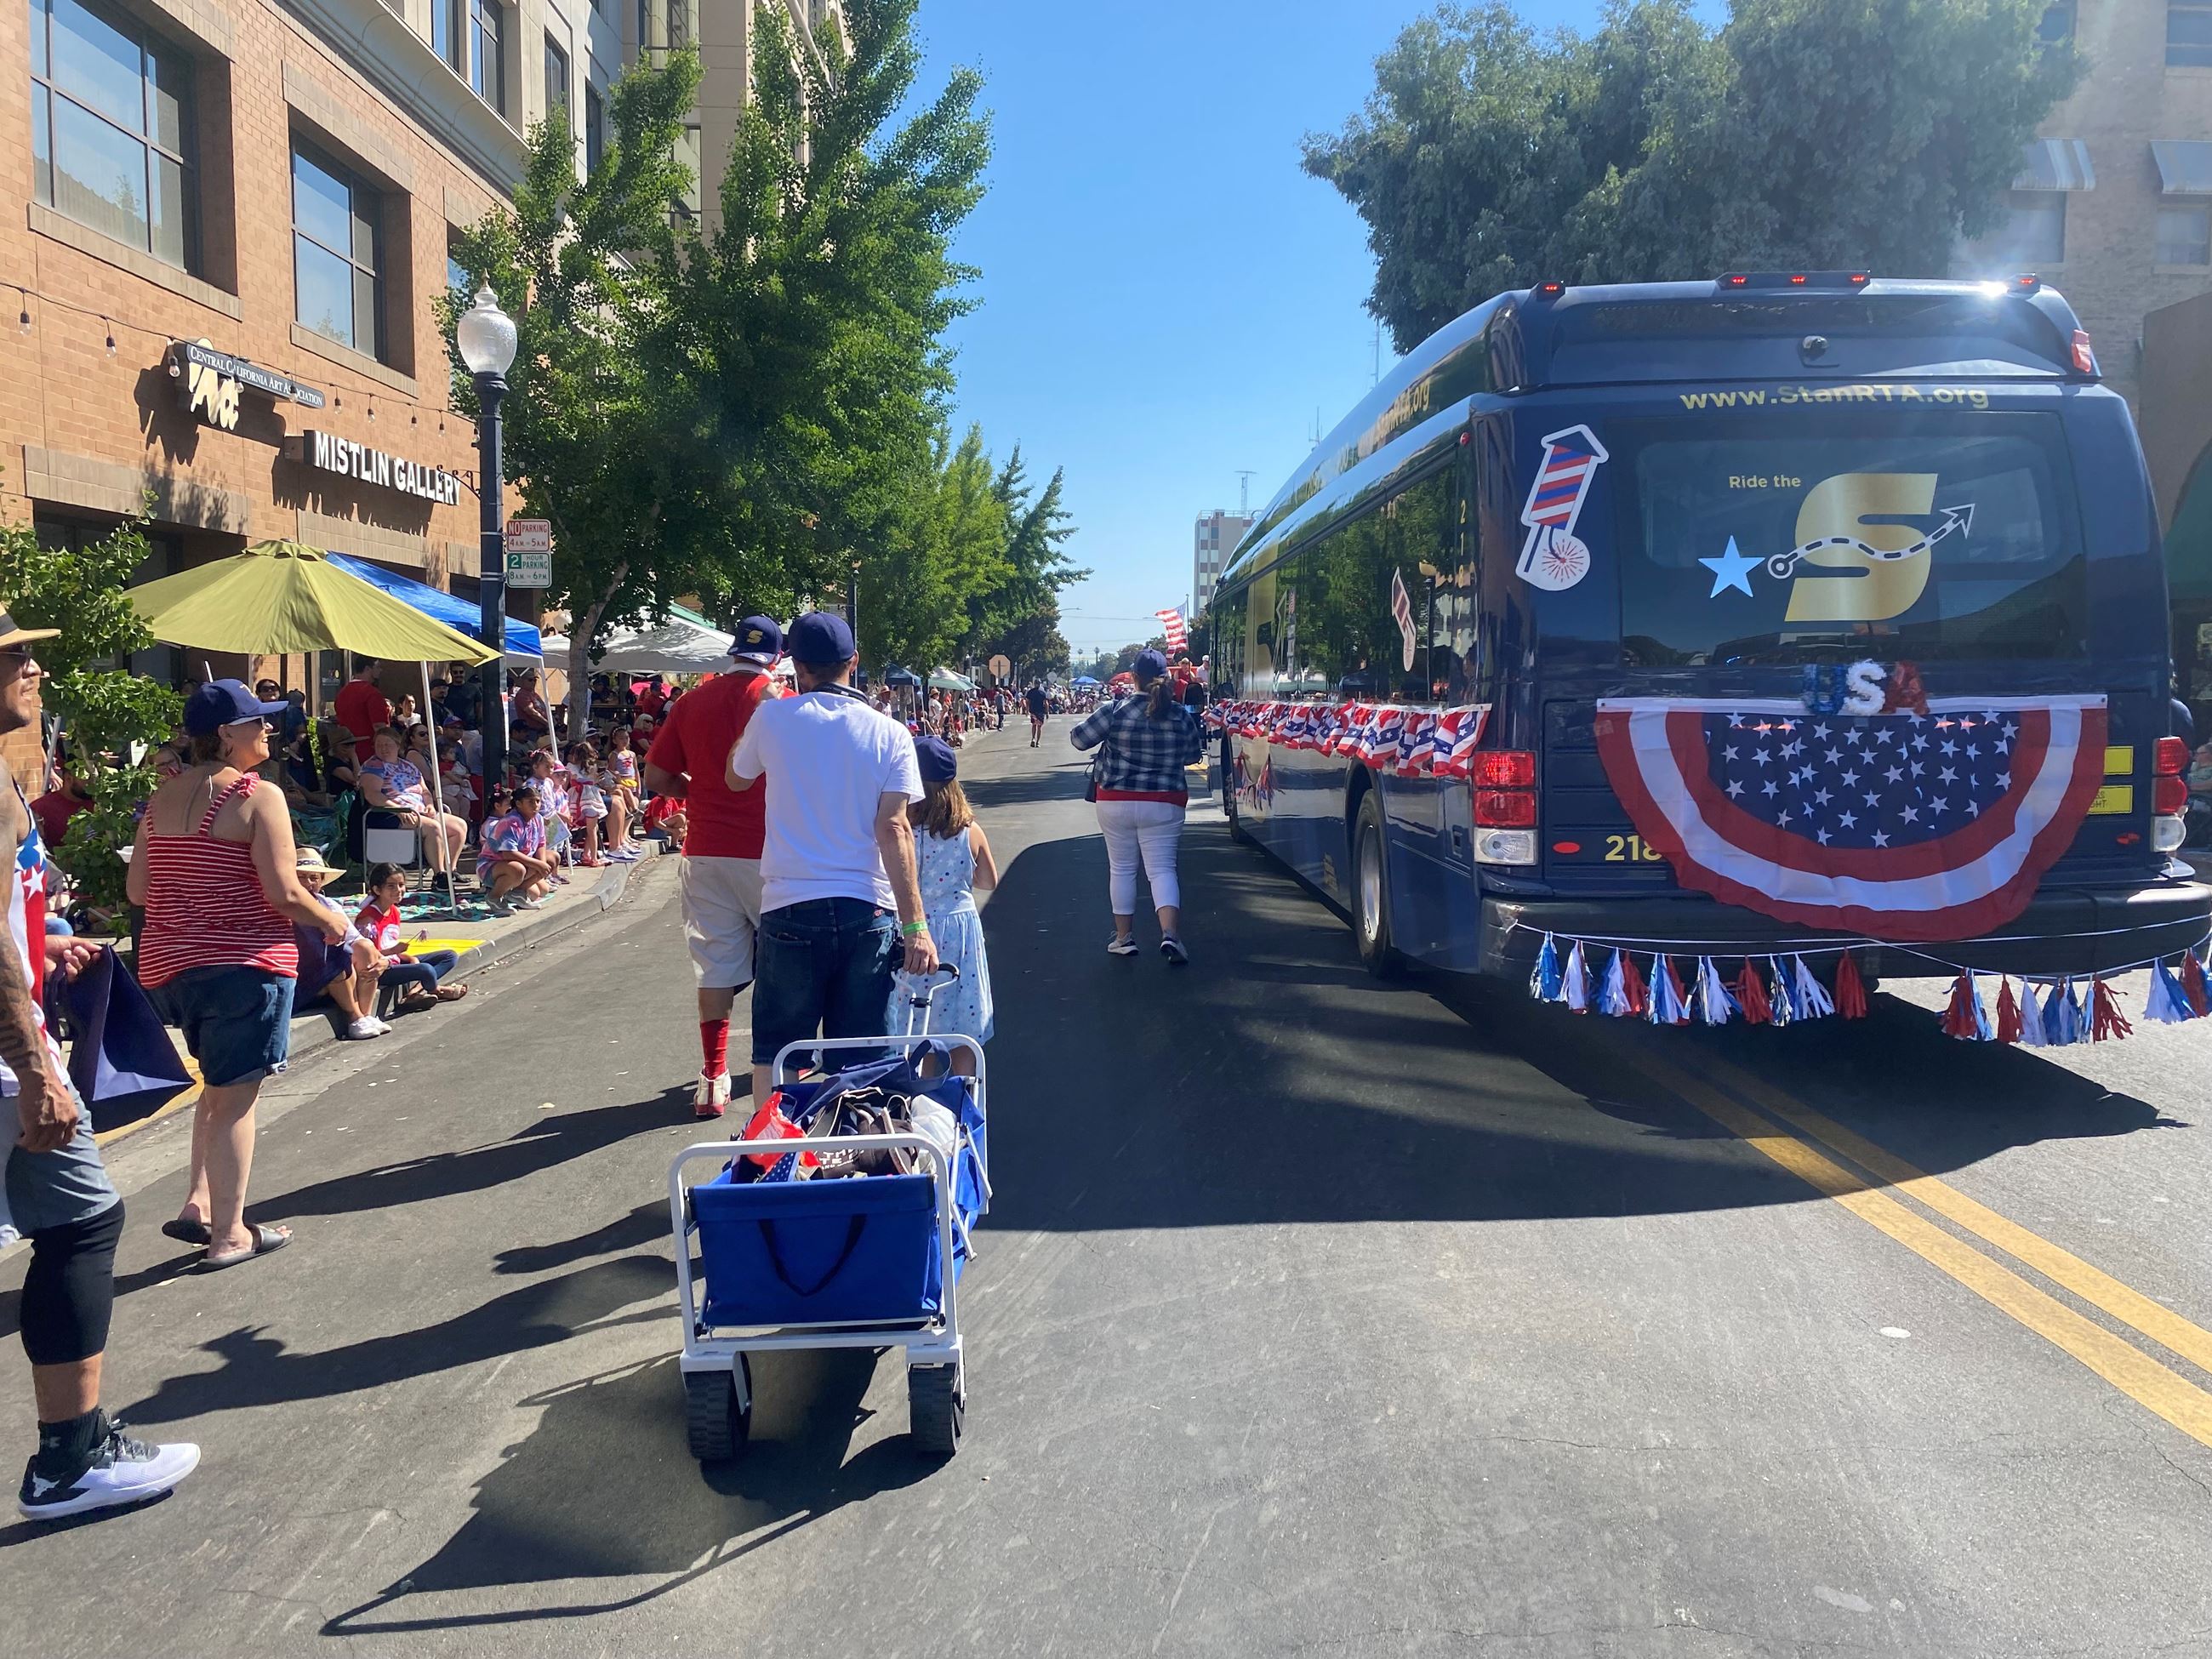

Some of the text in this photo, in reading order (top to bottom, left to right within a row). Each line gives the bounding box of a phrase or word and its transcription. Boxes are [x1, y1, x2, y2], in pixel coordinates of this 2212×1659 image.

[191, 346, 225, 370] CENTRAL
[269, 379, 283, 392] ART
[283, 383, 322, 407] ASCIATION
[1679, 385, 1989, 408] www.StanRTA.org
[314, 430, 461, 506] MISTLIN GALLERY
[1729, 475, 1801, 488] Ride the
[508, 522, 548, 535] NO PARKING
[510, 555, 519, 567] 2
[1803, 658, 1930, 715] USA
